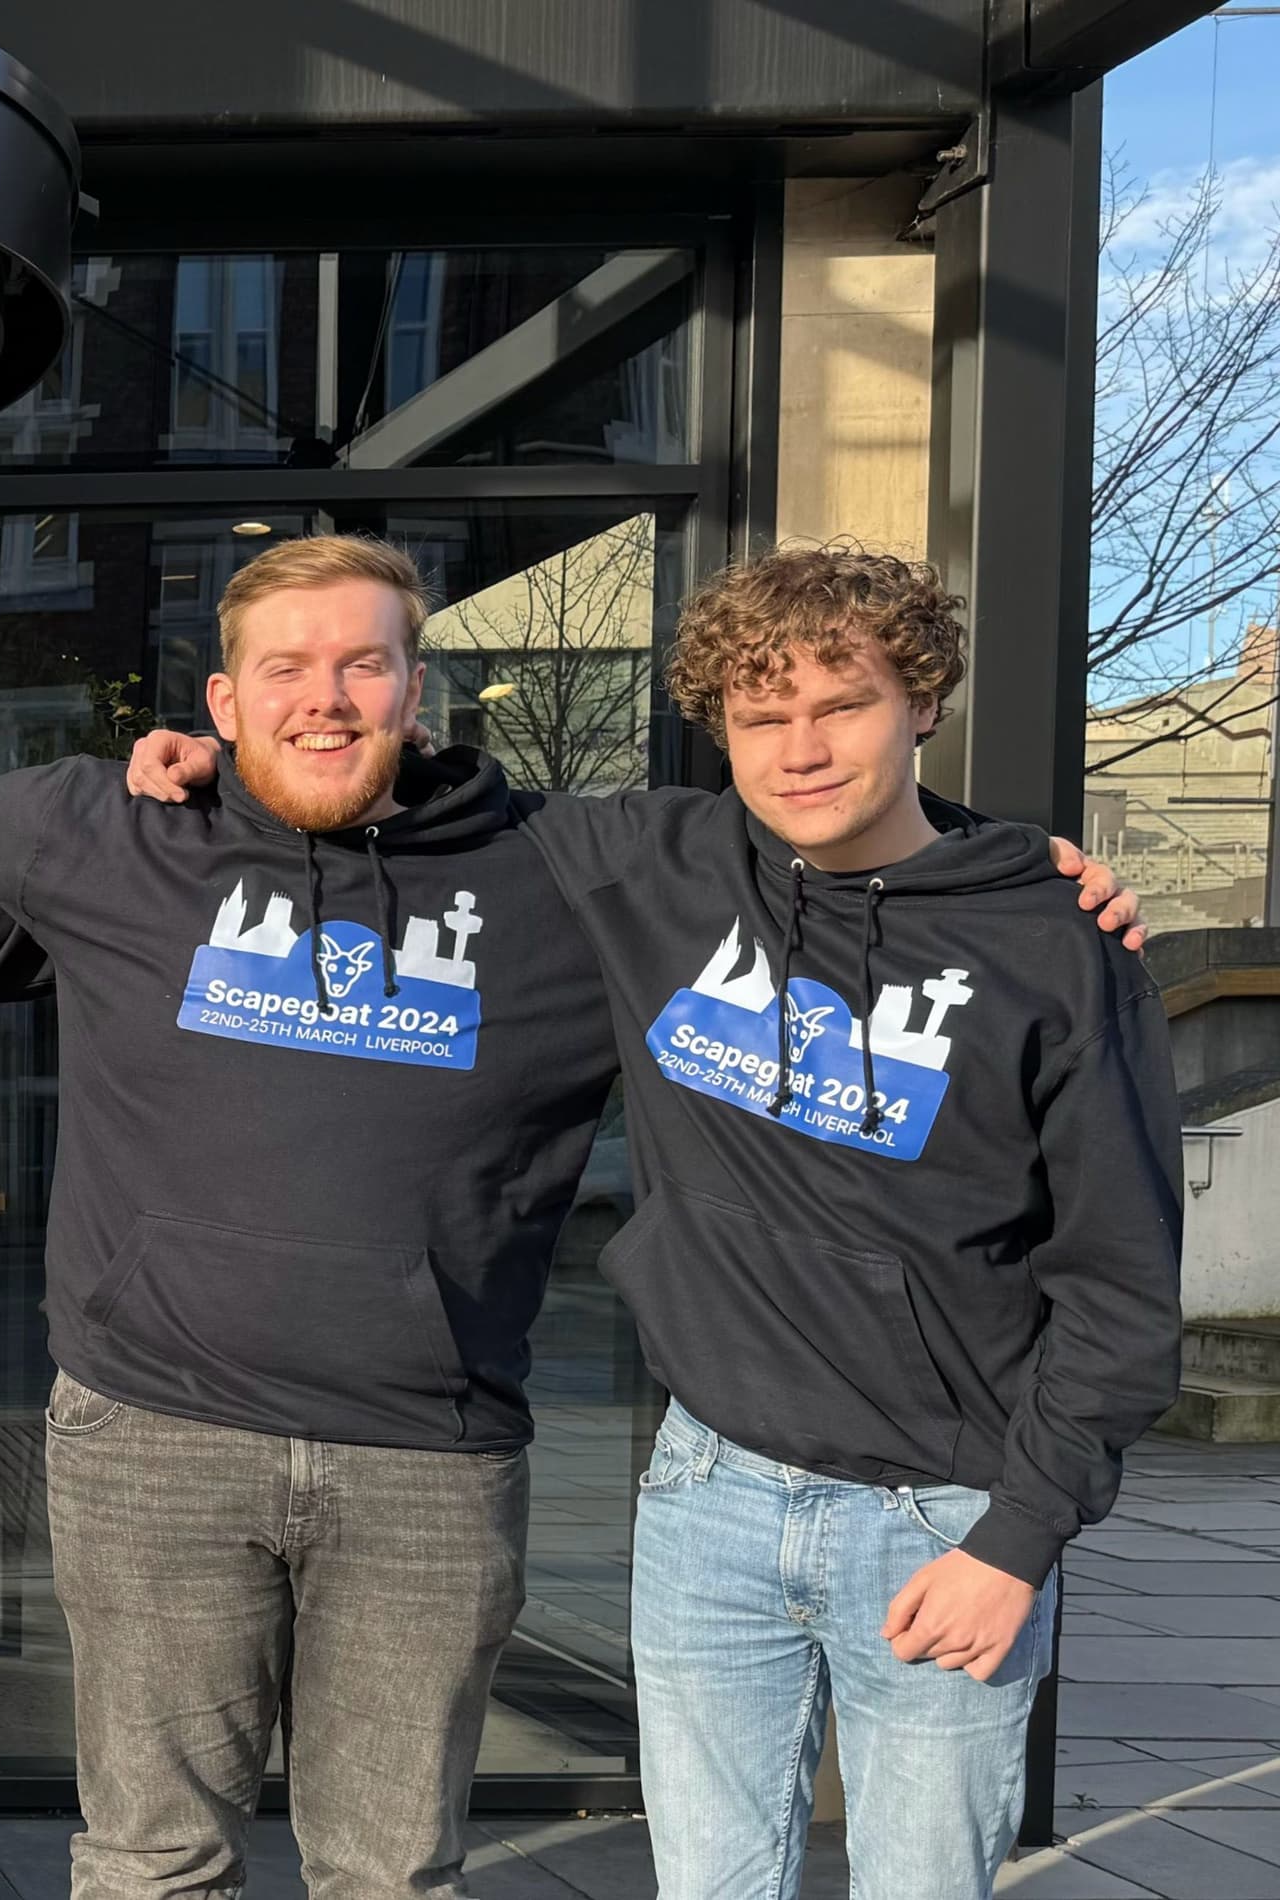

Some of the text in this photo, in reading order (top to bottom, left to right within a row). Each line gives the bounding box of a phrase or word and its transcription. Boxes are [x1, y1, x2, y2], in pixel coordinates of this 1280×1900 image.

[205, 979, 459, 1037] Scapegoat 2024
[199, 1009, 453, 1058] 22ND-25TH MARCH LIVERPOOL
[657, 1051, 744, 1095] 22ND-25TH
